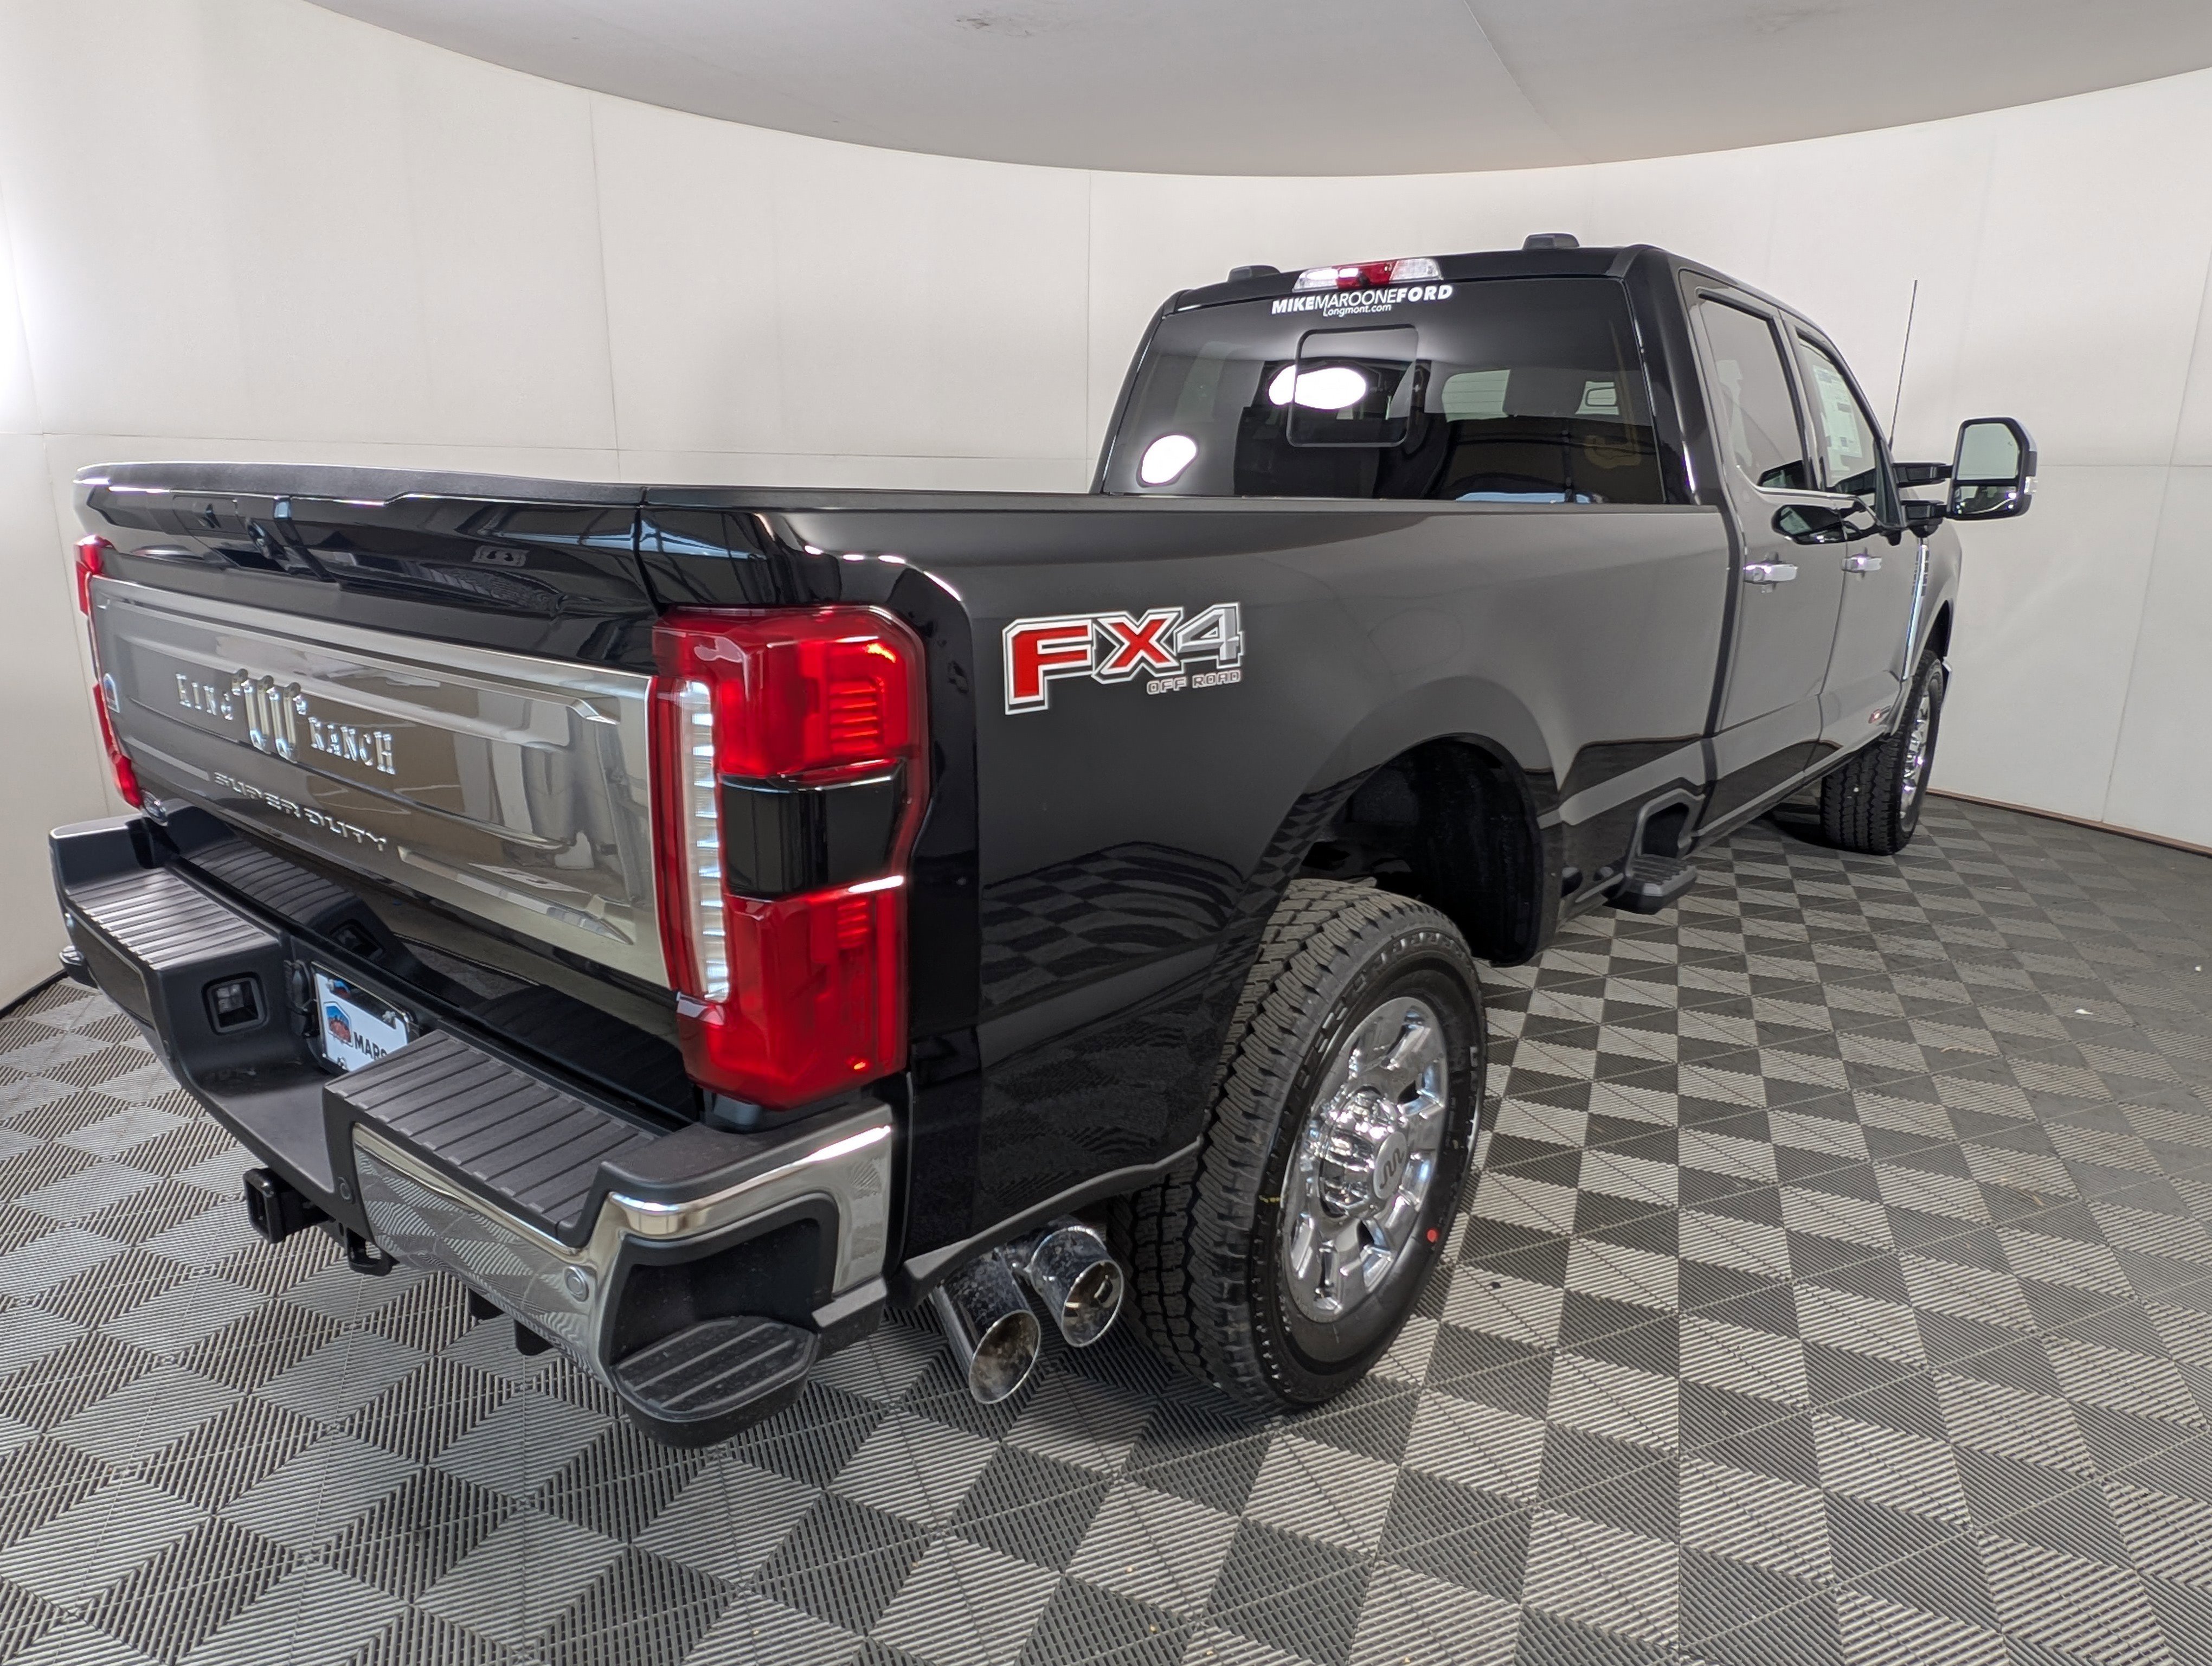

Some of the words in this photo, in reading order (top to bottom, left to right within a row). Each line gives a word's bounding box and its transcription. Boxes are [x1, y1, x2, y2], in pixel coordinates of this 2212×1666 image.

[1323, 302, 1392, 318] Longmont.com
[1002, 601, 1245, 715] FX4
[1147, 676, 1188, 695] OFF
[1192, 669, 1242, 689] ROAD
[308, 716, 396, 775] RANCH
[214, 771, 301, 818] SUPER
[304, 807, 387, 851] DUTY
